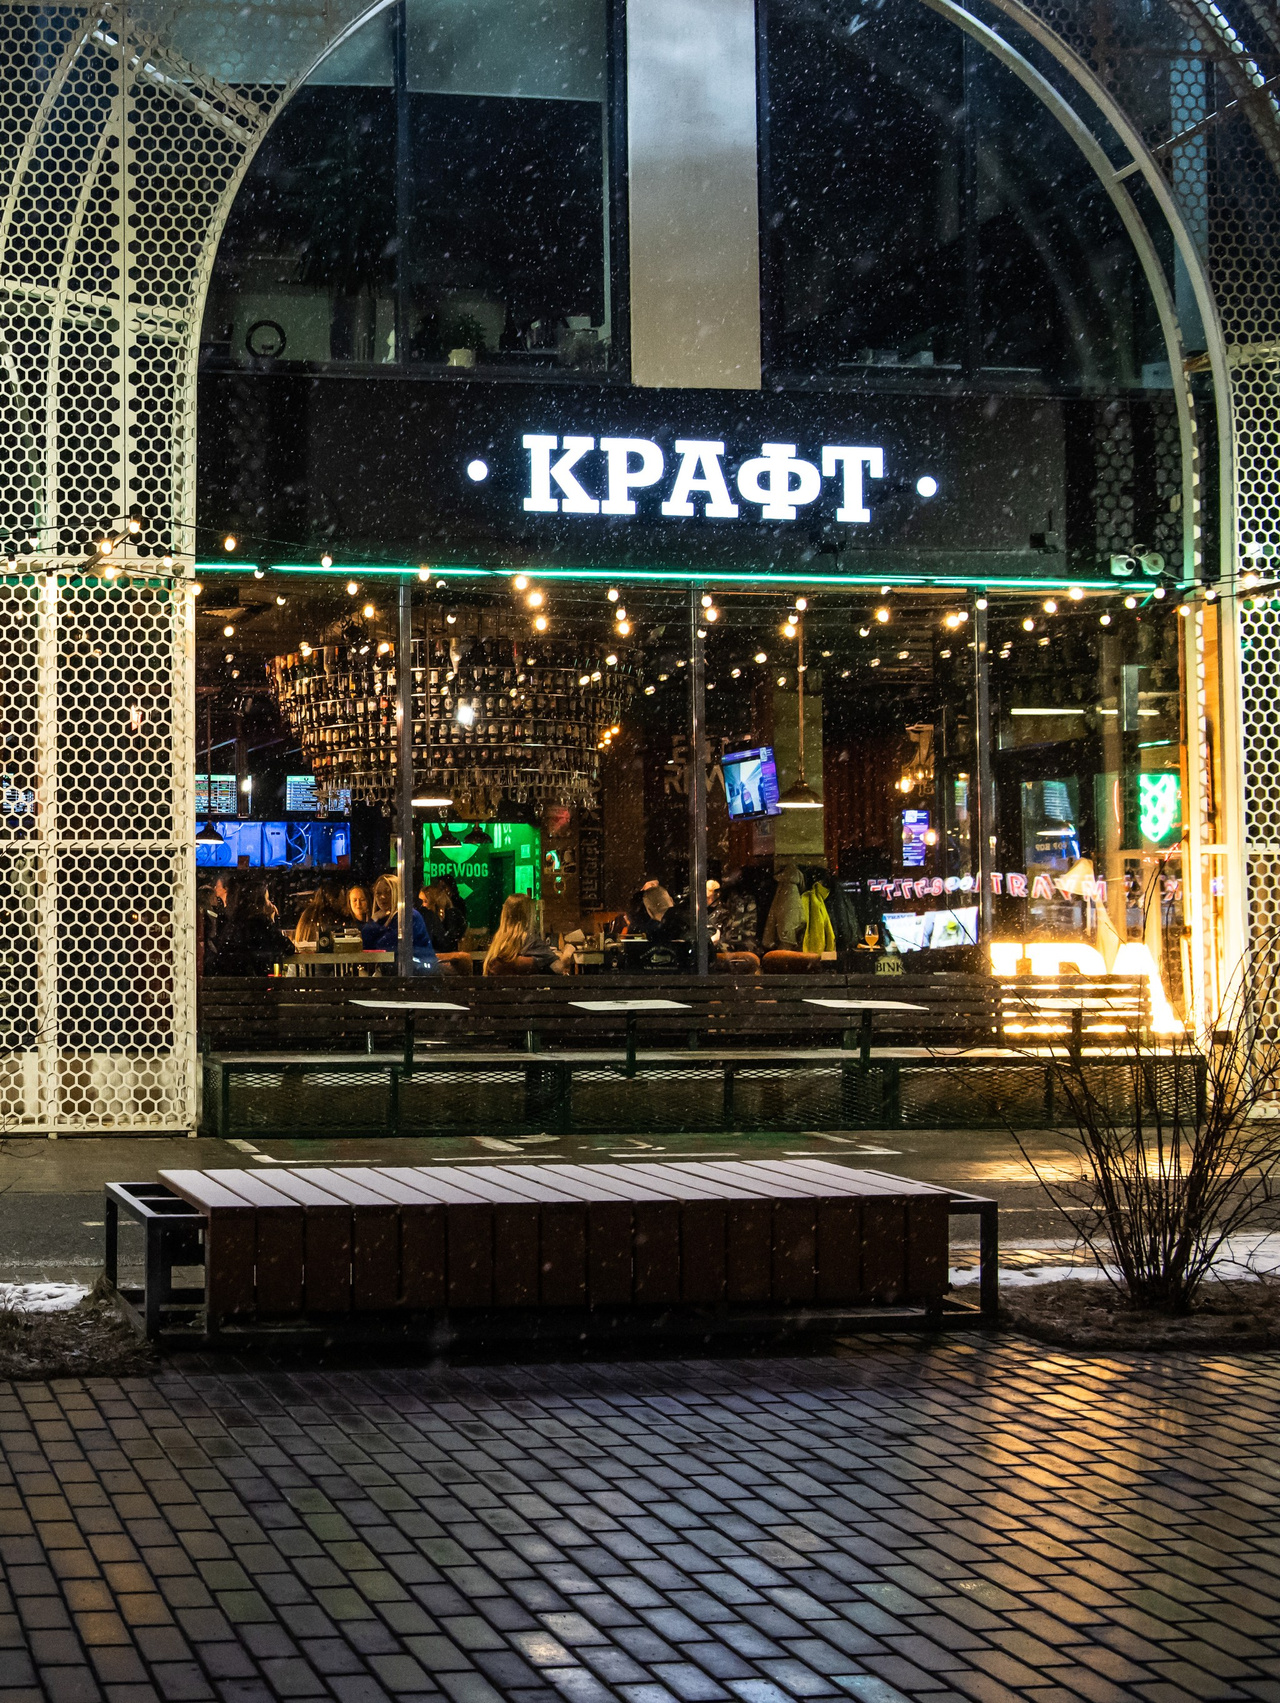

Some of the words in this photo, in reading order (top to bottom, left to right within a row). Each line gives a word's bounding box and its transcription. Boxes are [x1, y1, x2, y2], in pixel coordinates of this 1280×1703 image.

[521, 434, 885, 523] КРАФТ
[430, 863, 489, 878] BREWDOG
[876, 962, 904, 974] BINK
